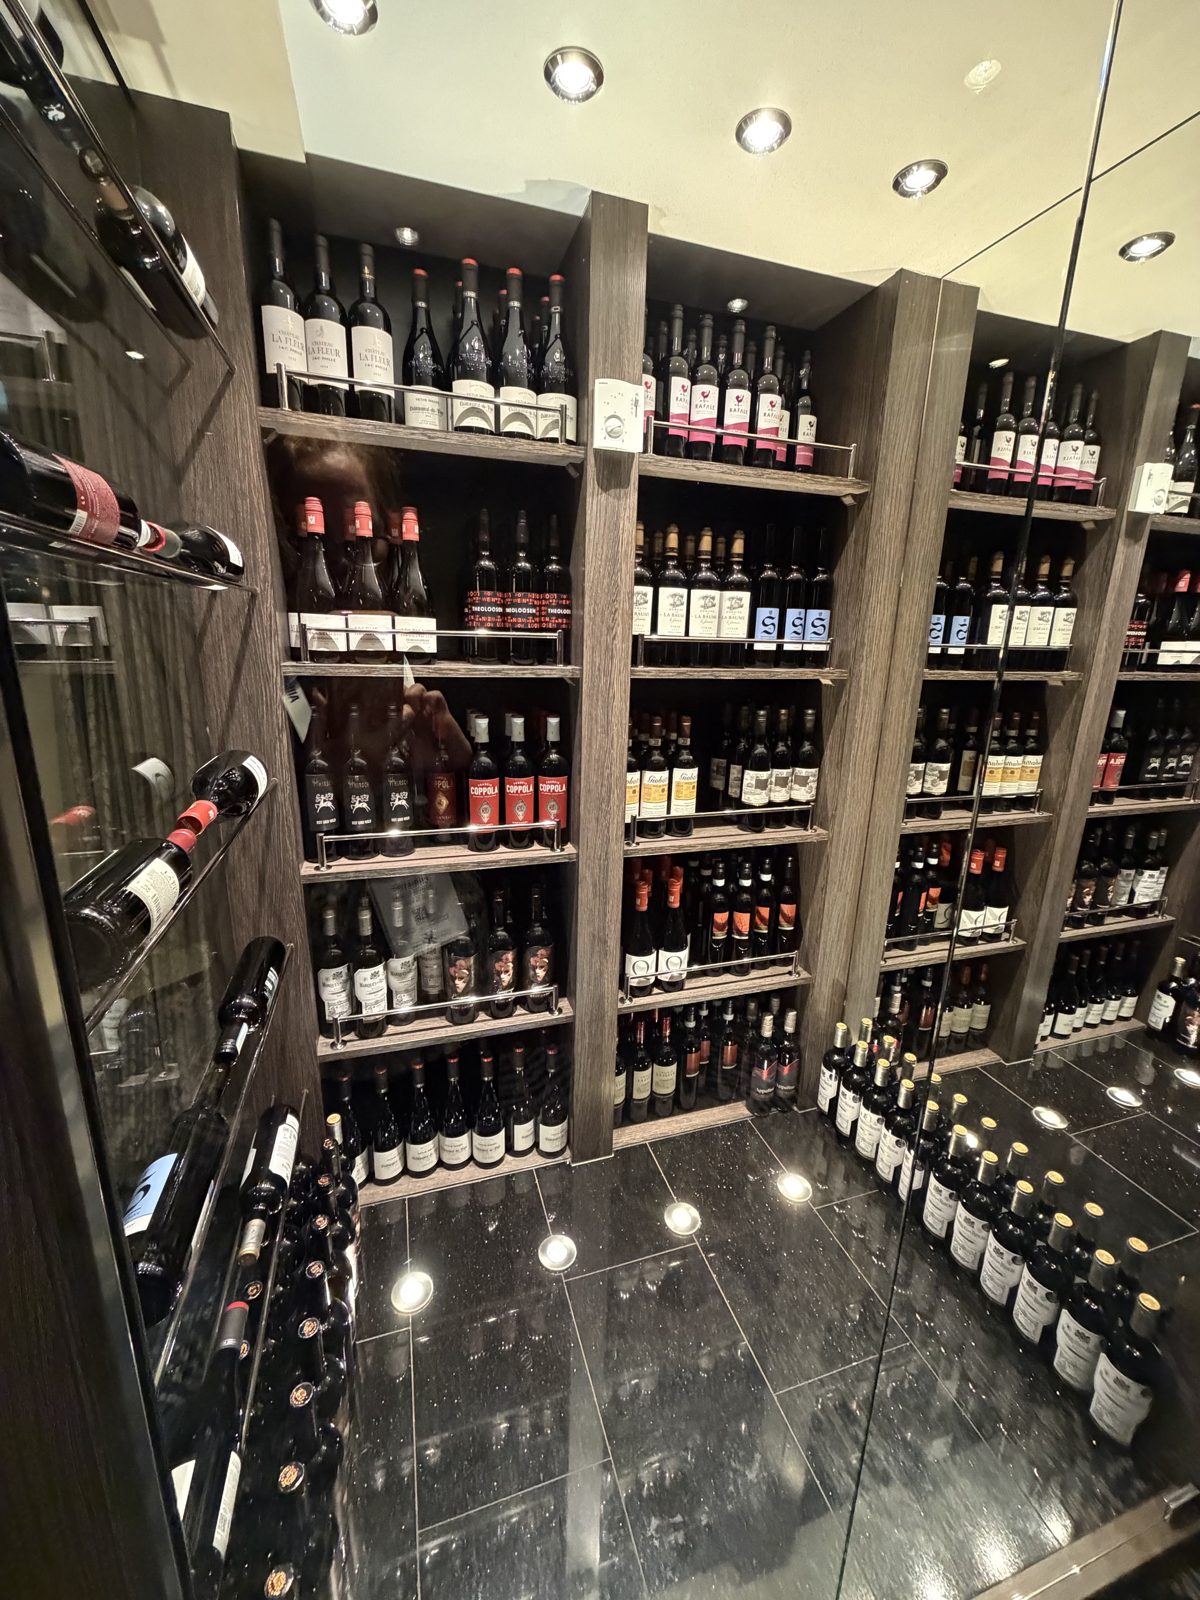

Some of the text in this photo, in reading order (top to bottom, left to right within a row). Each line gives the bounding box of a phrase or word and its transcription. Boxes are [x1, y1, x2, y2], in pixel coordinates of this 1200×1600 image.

[271, 332, 283, 343] LA
[317, 347, 341, 359] FLEUR
[359, 352, 369, 362] LA
[761, 615, 776, 635] S
[810, 617, 826, 636] S
[470, 786, 499, 796] COPPOLA
[506, 783, 533, 794] COPPOLA
[539, 783, 567, 793] COPPOLA
